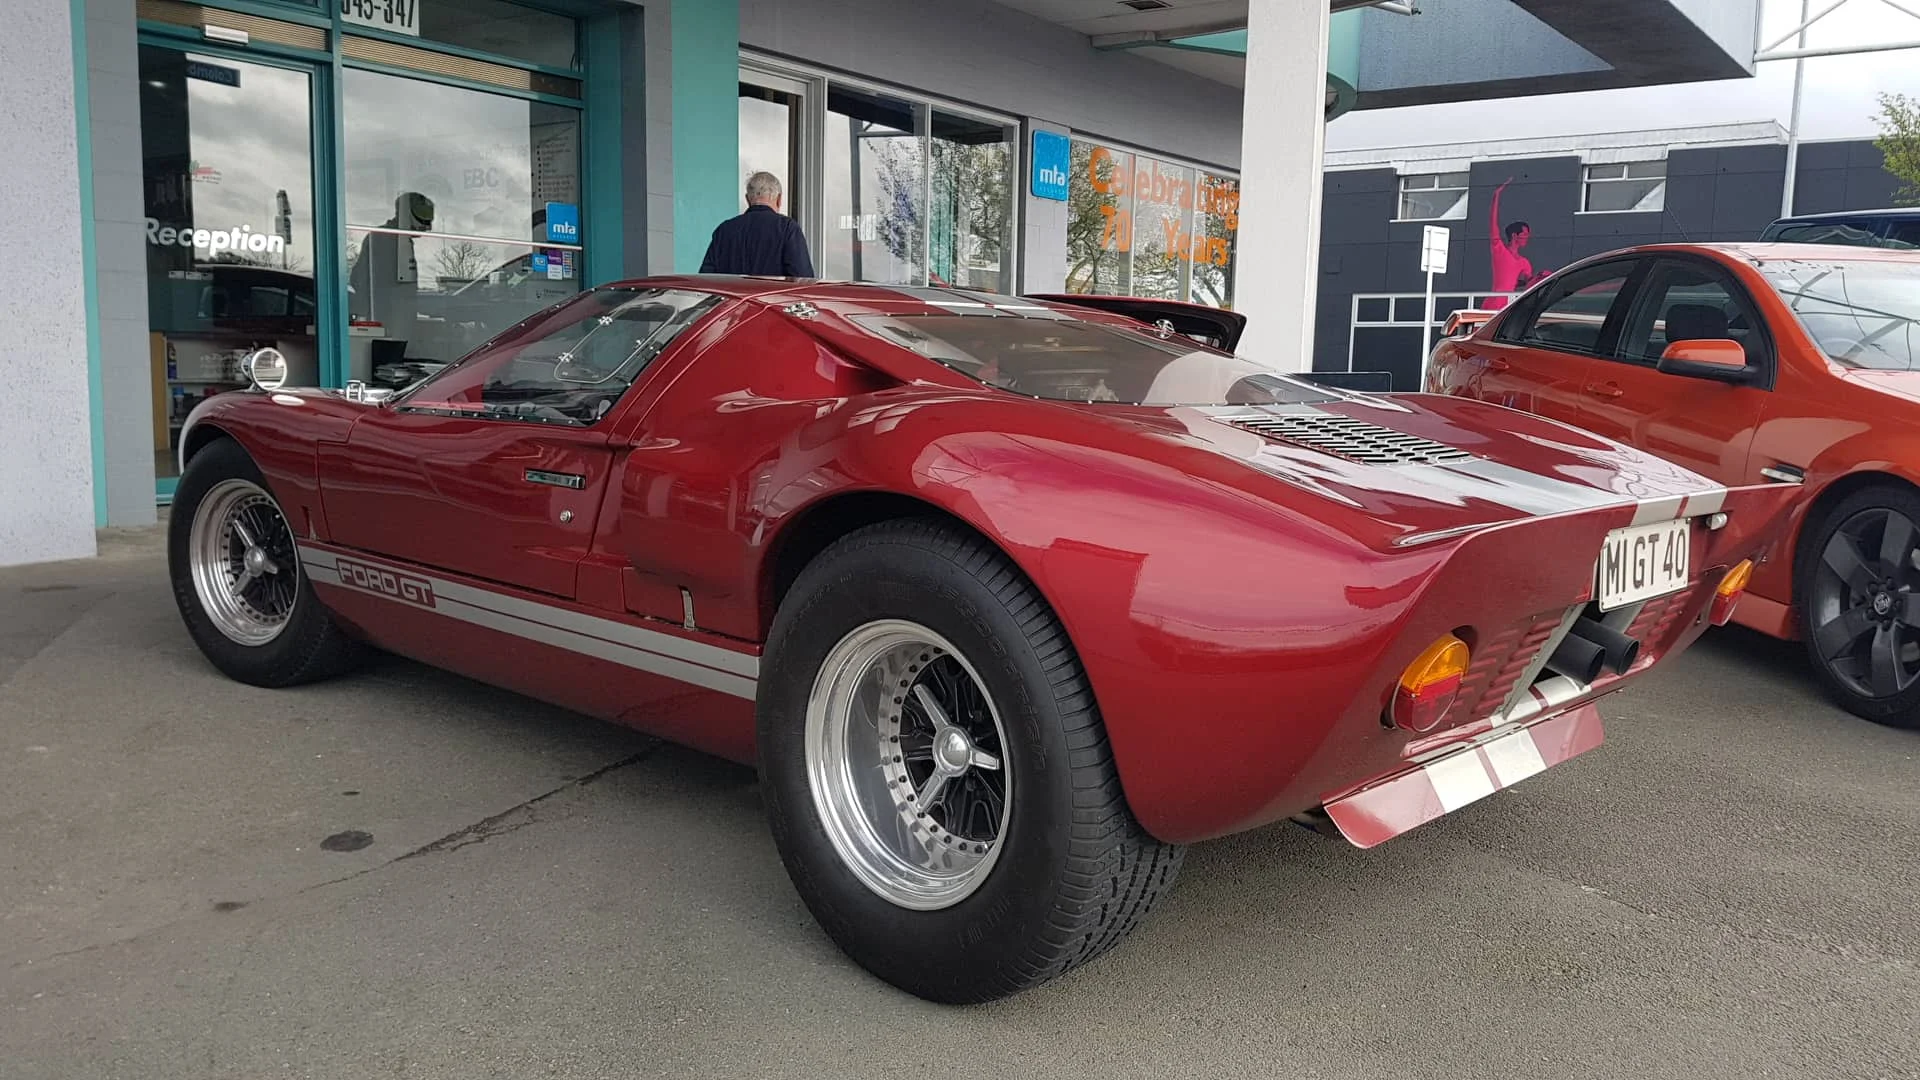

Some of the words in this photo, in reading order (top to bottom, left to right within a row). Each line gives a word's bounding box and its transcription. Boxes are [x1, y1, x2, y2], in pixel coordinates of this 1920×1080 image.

[1039, 164, 1066, 186] mta
[1090, 147, 1239, 231] Celebrating
[145, 217, 284, 258] Reception
[552, 220, 577, 234] mta
[1100, 205, 1131, 253] 70
[1163, 218, 1229, 267] Years
[337, 561, 399, 596] FORD
[400, 577, 431, 604] GT
